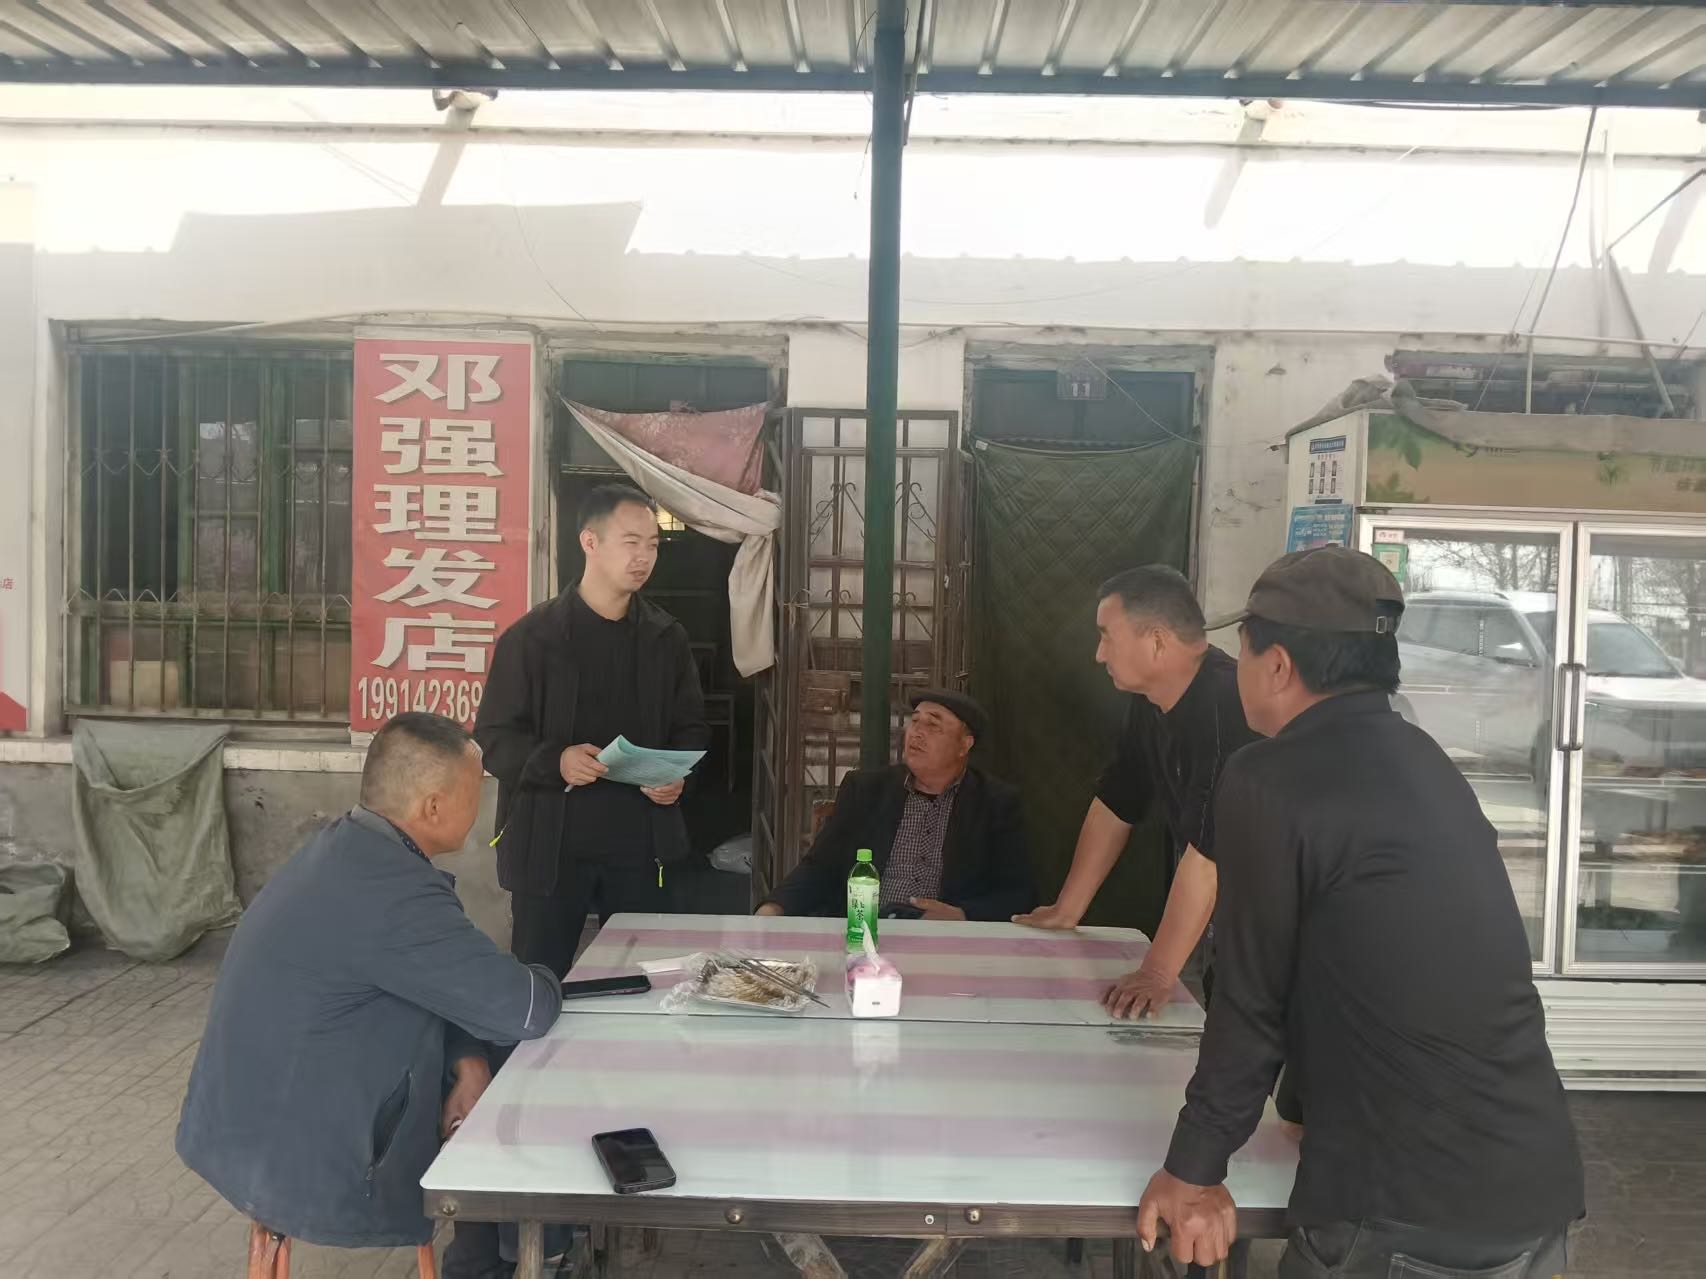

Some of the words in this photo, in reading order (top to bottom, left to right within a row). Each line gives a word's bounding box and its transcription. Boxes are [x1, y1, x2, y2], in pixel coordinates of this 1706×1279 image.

[370, 353, 504, 673] 邓强理发店
[358, 677, 483, 723] 199142369
